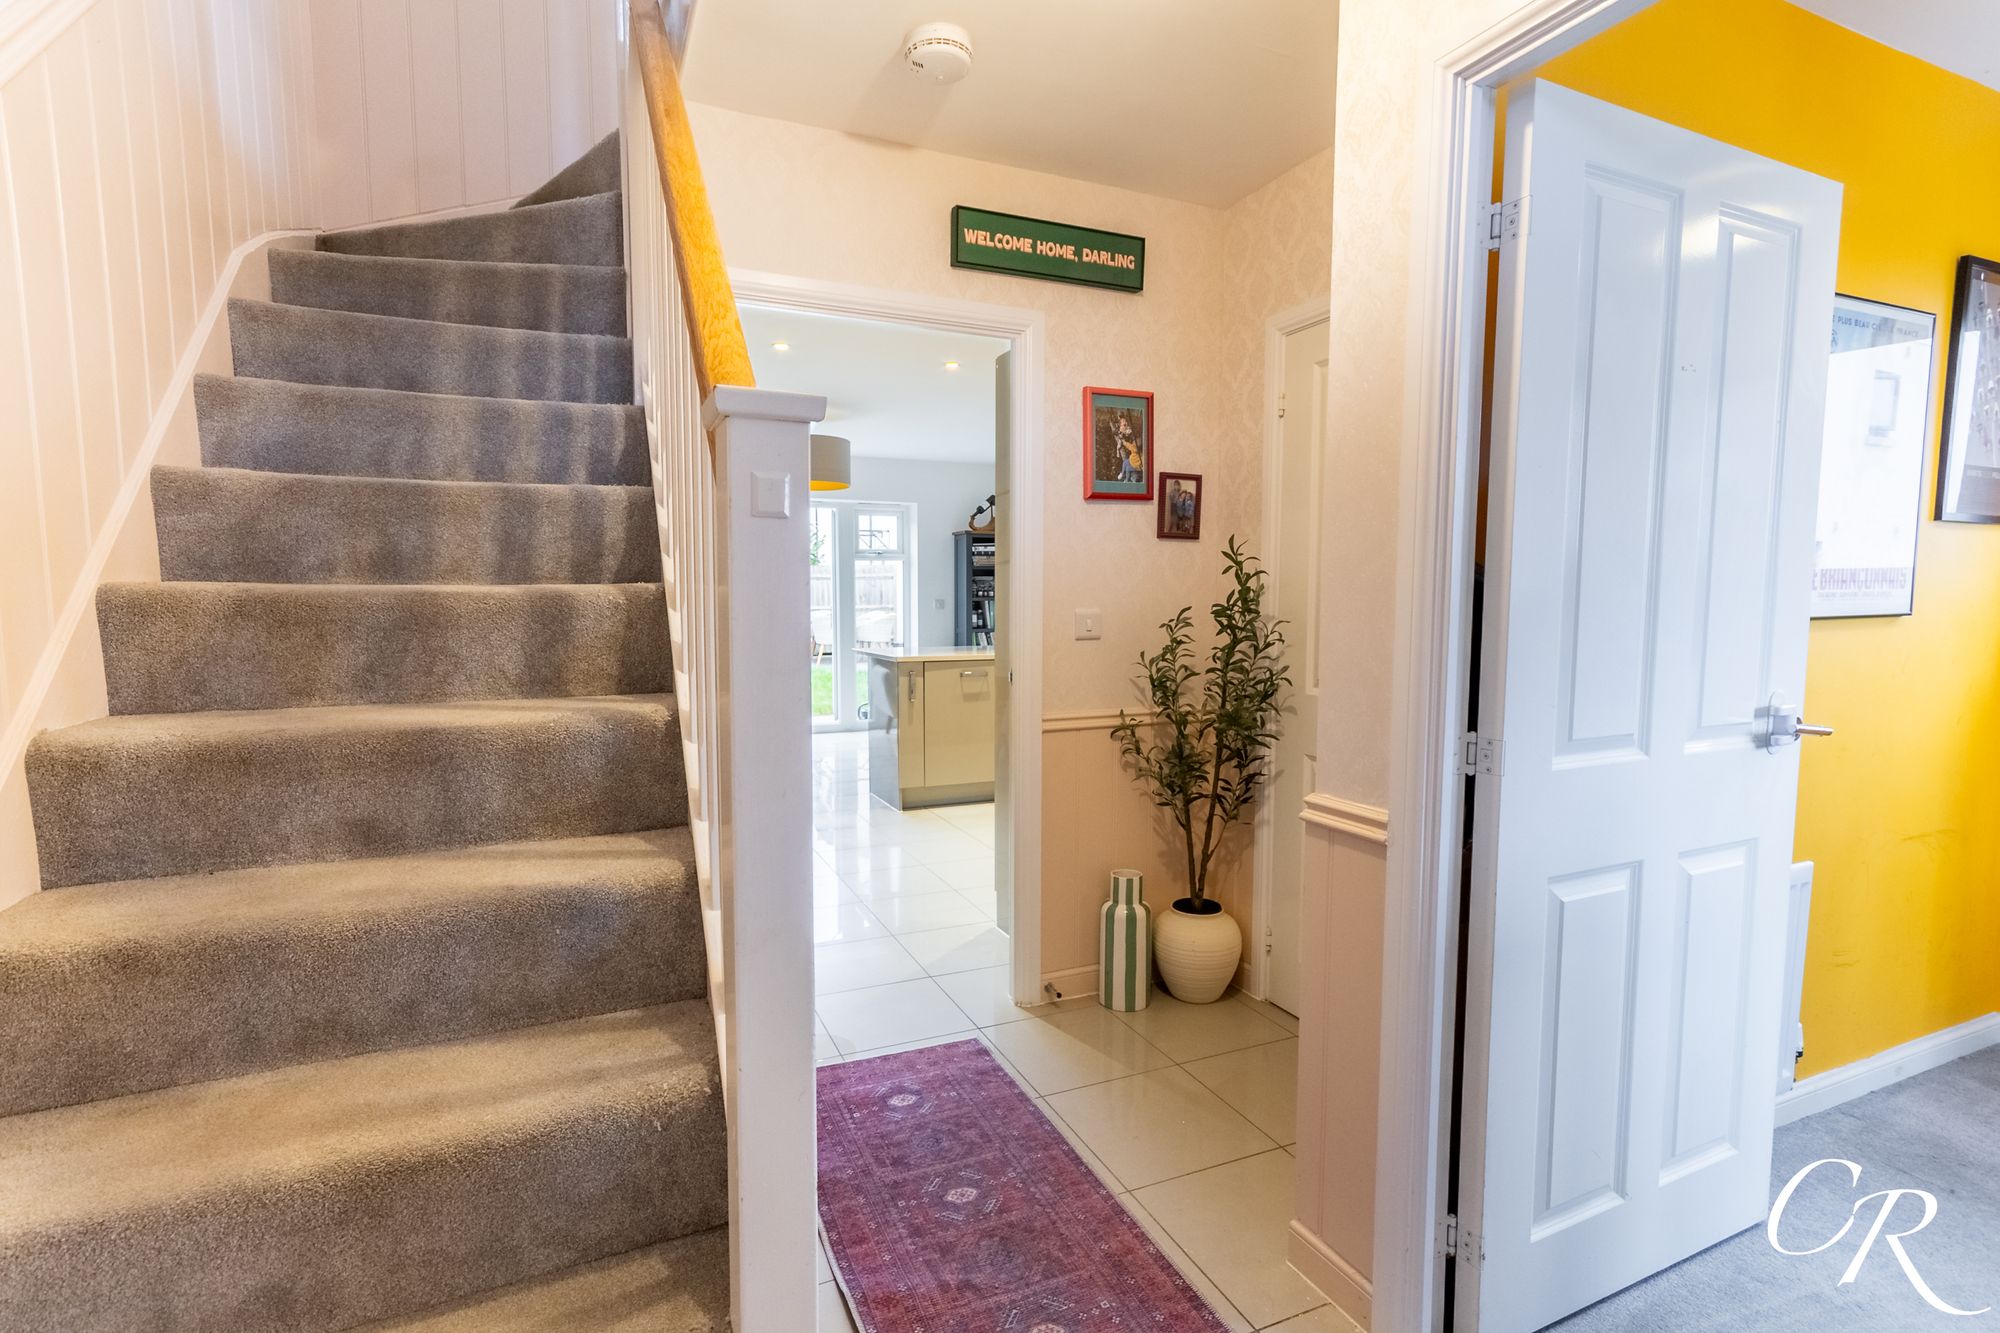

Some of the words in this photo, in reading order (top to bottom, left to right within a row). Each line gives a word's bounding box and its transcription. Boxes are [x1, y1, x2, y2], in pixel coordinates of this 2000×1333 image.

[963, 228, 1033, 253] WELCOME
[1036, 240, 1078, 263] HOME,
[1082, 248, 1135, 269] DARLING
[1837, 315, 1852, 326] PLUS
[1854, 319, 1870, 329] BEAU
